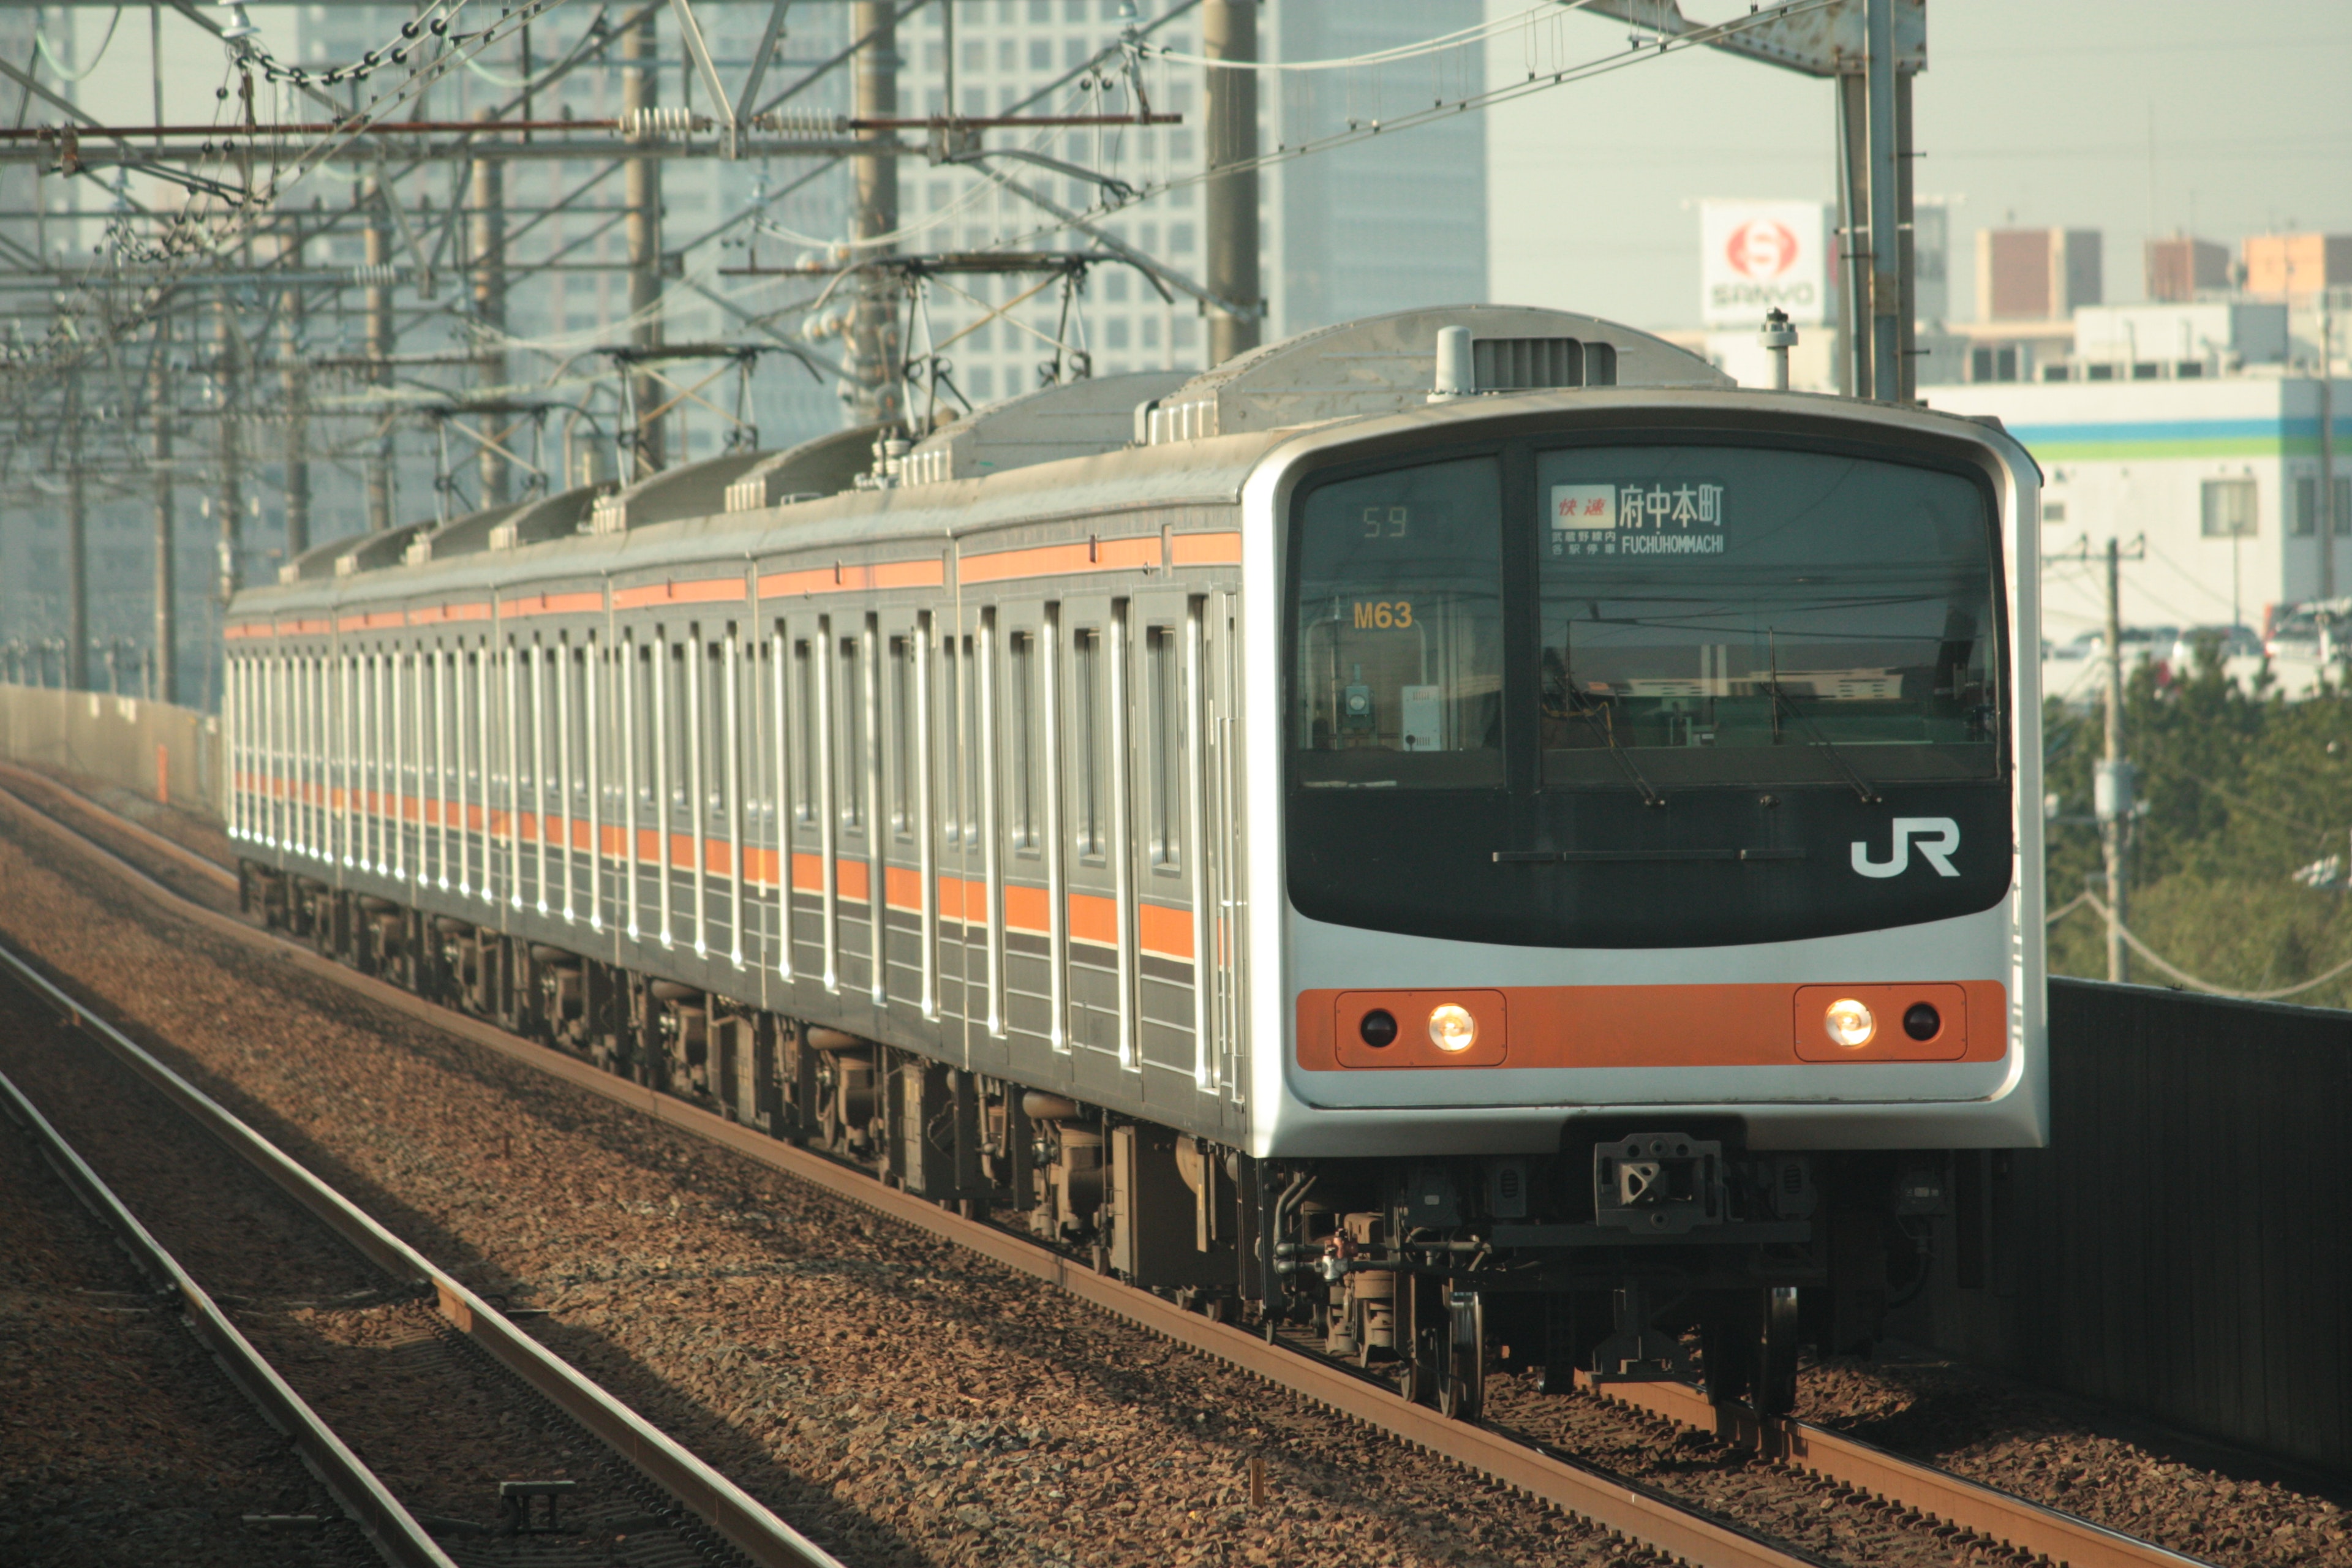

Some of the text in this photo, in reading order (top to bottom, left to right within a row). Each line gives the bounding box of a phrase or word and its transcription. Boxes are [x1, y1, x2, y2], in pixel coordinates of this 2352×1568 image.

[1558, 497, 1607, 516] 快速
[1619, 483, 1724, 529] 府中本町
[1364, 507, 1406, 538] 59
[1552, 531, 1616, 543] 武蔵野線内
[1552, 544, 1616, 555] 各駅停車
[1354, 601, 1412, 629] M63
[1851, 817, 1961, 878] JR
